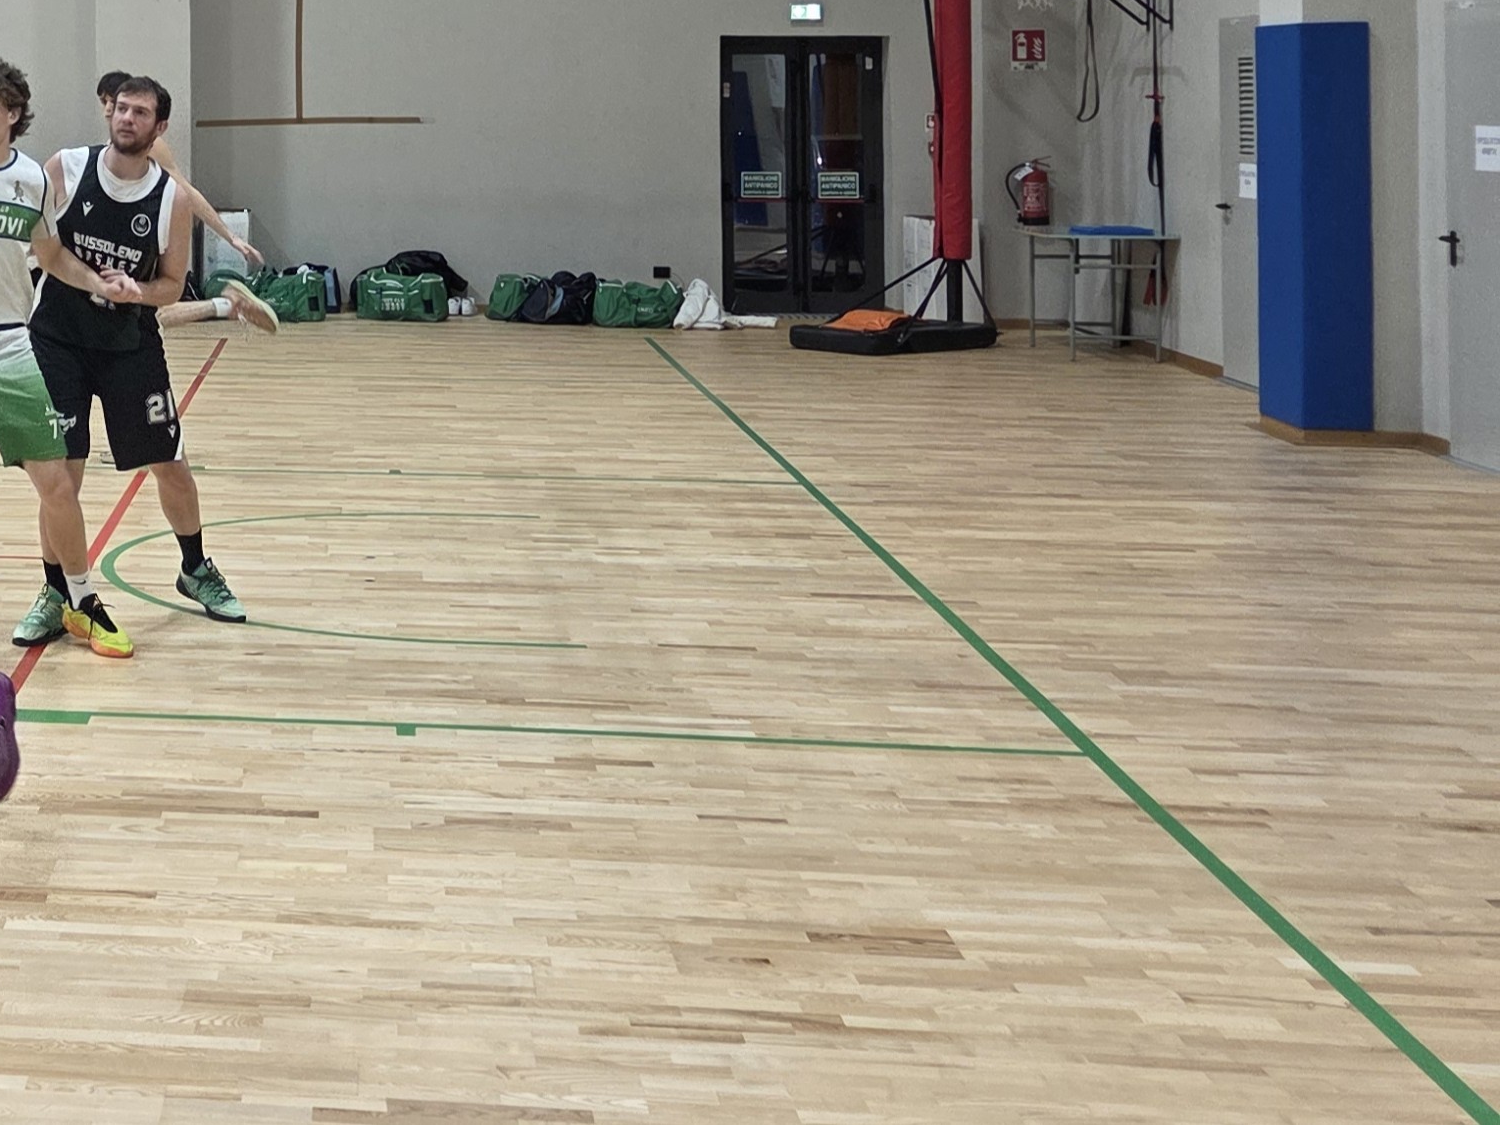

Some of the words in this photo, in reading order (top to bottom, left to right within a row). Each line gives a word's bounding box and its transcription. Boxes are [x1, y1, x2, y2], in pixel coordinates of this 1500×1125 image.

[73, 231, 143, 263] BUSSOLENO
[145, 389, 176, 425] 21
[49, 418, 58, 440] 7
